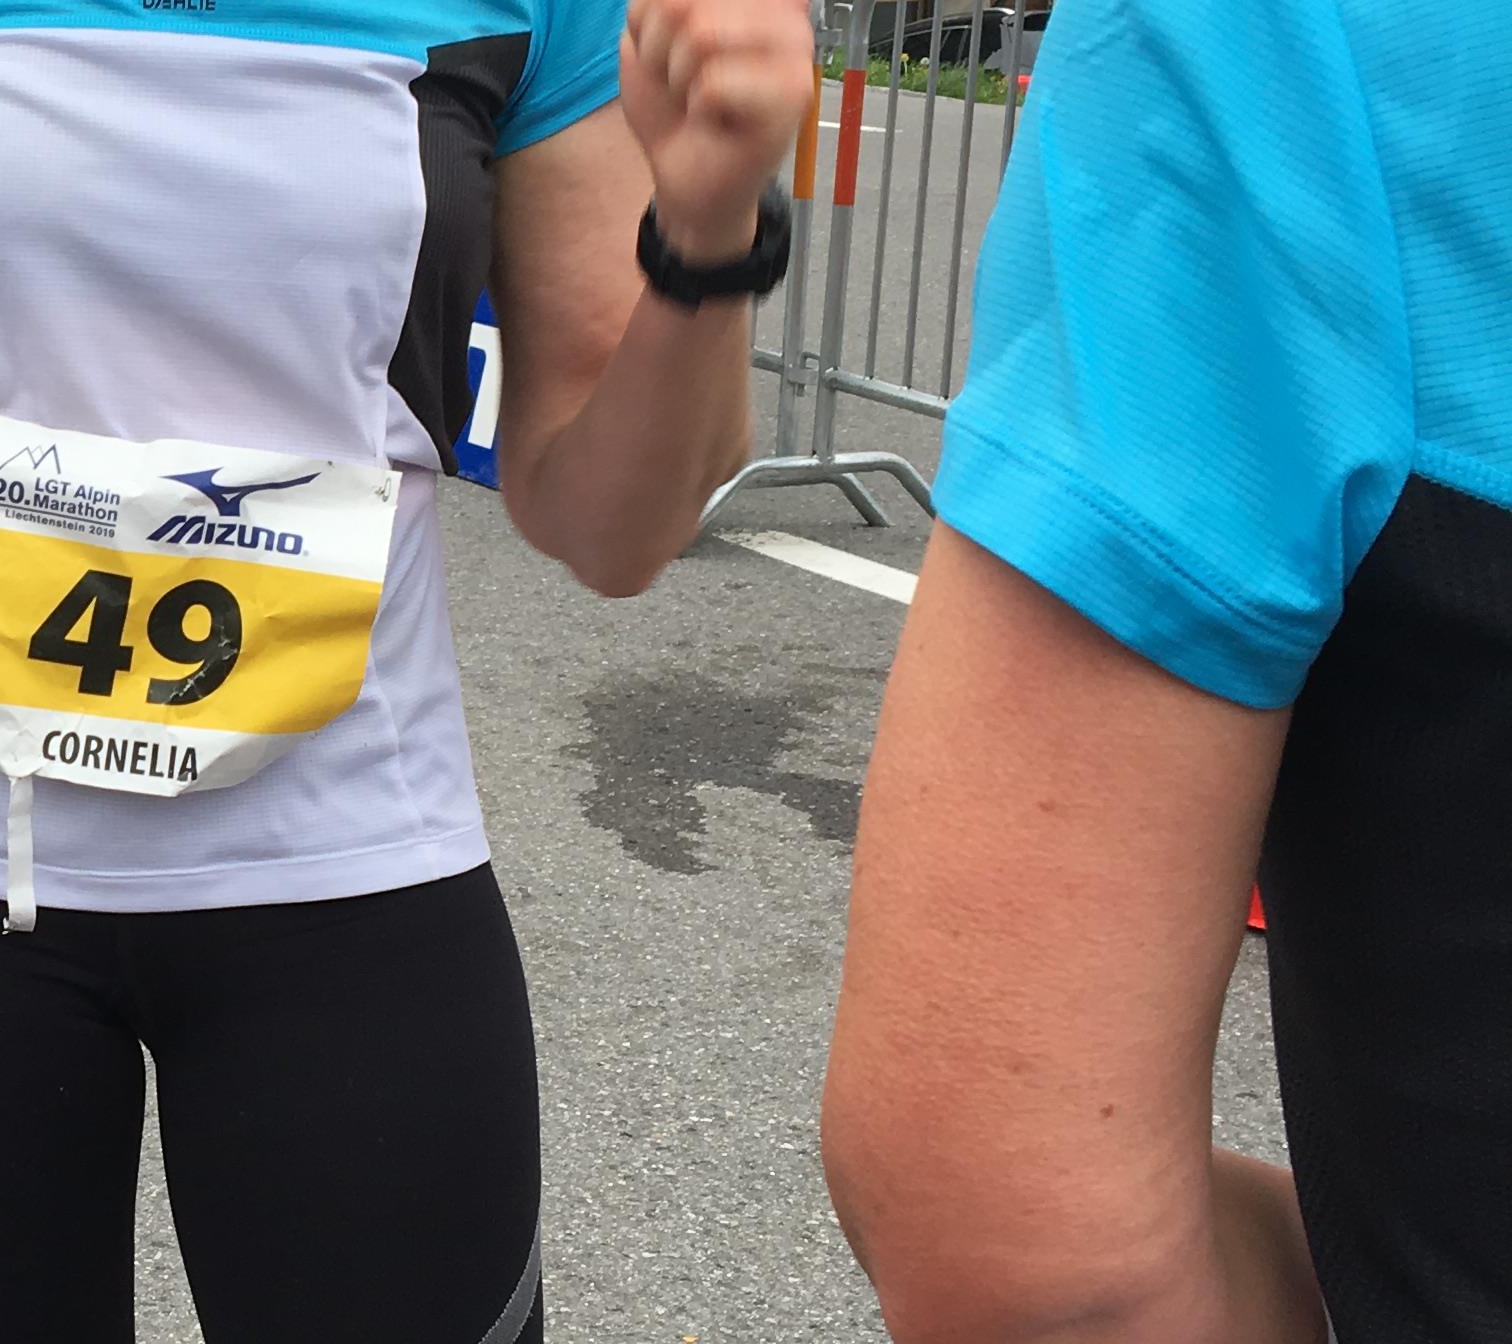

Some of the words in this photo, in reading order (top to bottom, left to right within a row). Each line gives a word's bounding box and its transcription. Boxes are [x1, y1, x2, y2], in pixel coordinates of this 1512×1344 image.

[33, 493, 119, 523] Marathon
[35, 476, 72, 497] LGT
[73, 484, 121, 506] Alpin
[5, 509, 86, 534] Liechtenstein
[89, 525, 116, 539] 2019
[146, 515, 304, 556] MIZUNO
[27, 569, 243, 706] 49
[42, 730, 198, 782] CORNELIA
